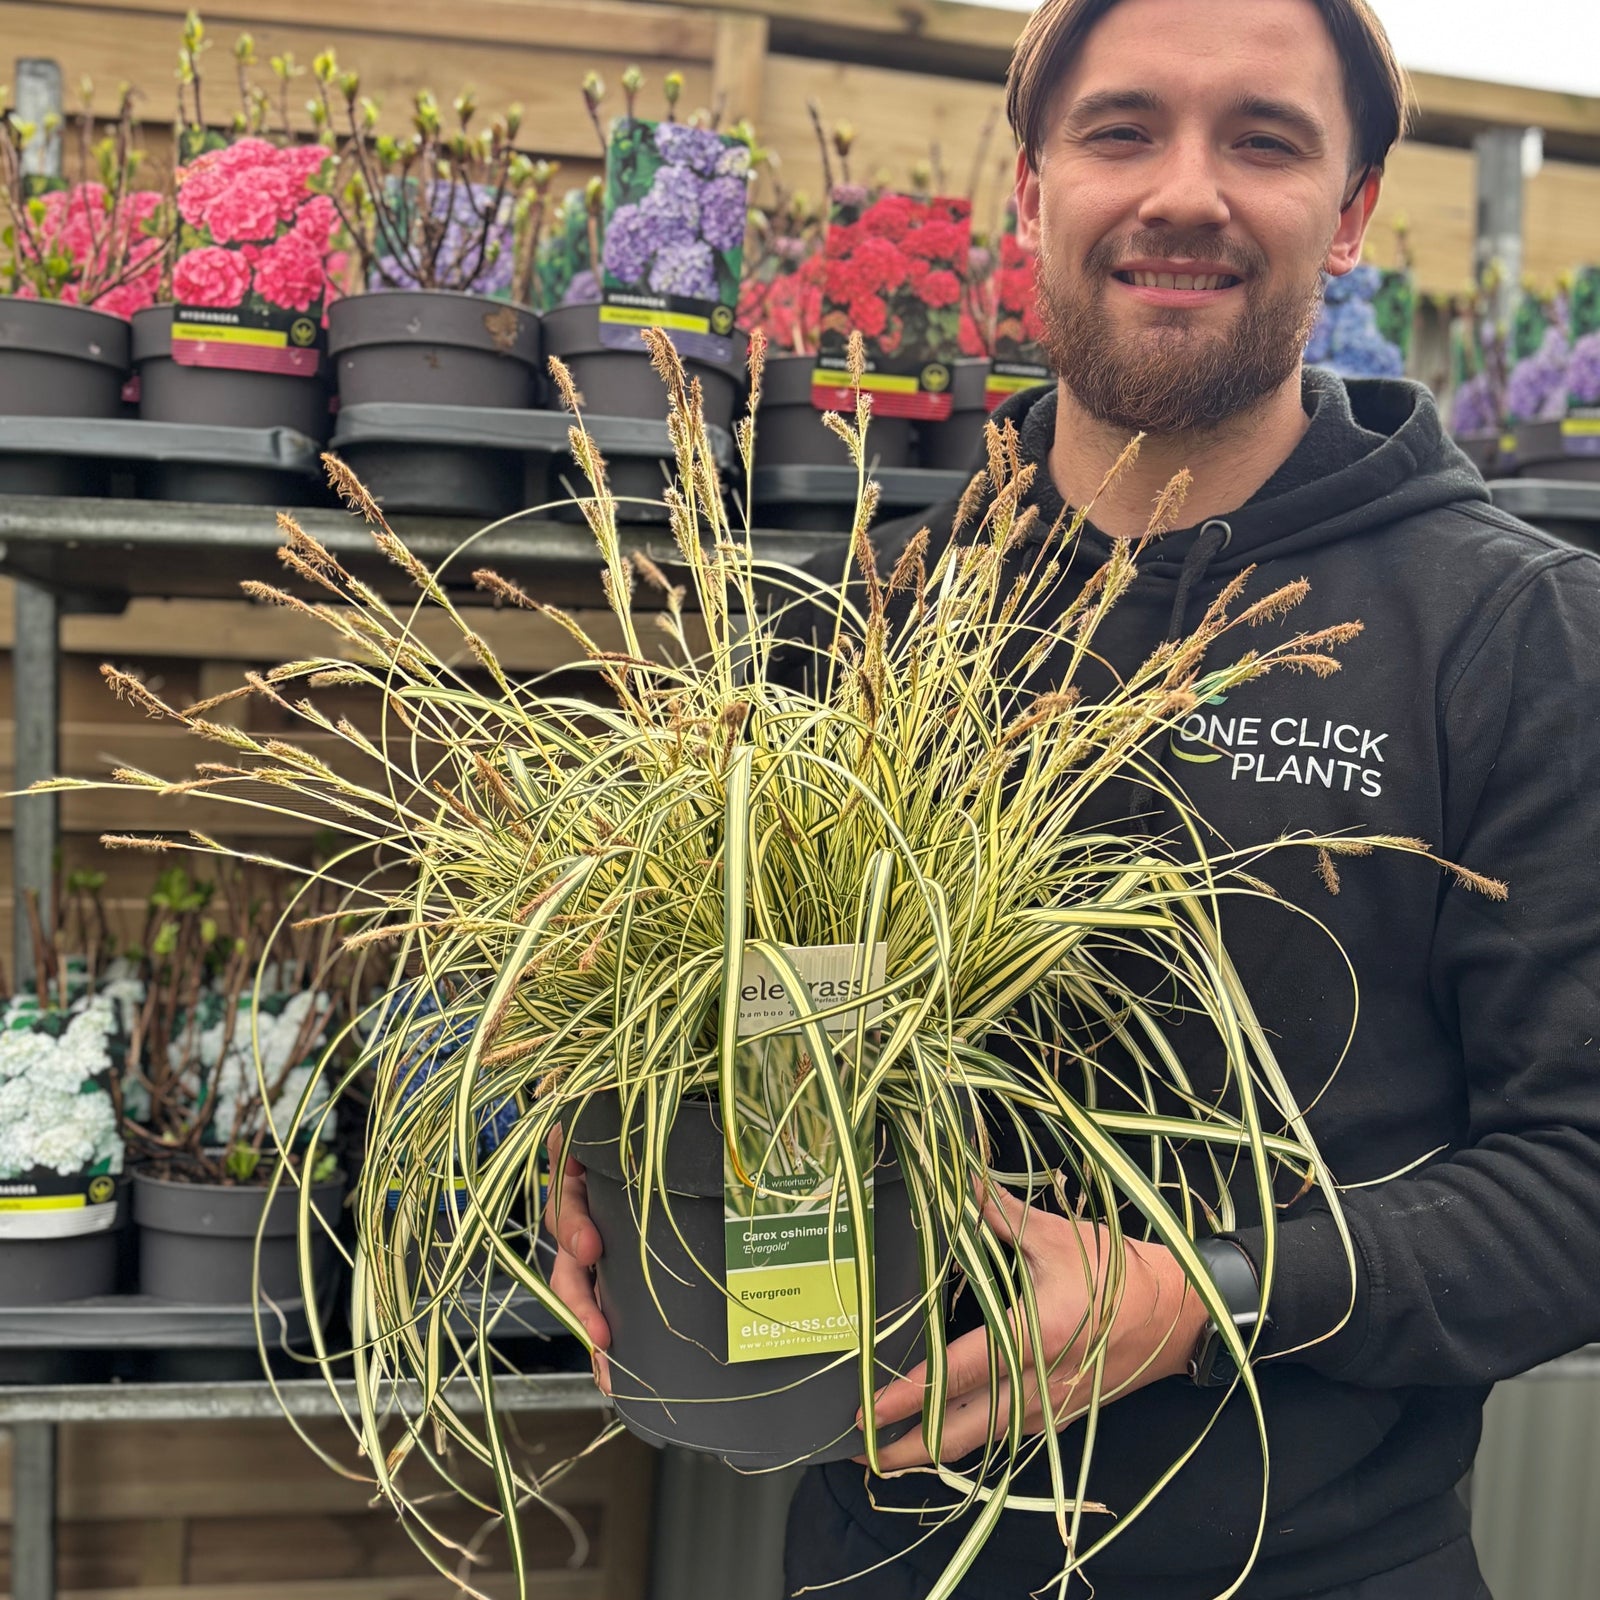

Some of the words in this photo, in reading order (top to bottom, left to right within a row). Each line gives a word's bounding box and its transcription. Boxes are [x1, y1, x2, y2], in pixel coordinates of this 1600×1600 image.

[1180, 713, 1261, 747] ONE
[1269, 717, 1389, 763] CLICK
[1231, 753, 1382, 798] PLANTS
[741, 975, 861, 1004] elerass
[739, 1009, 784, 1018] bamboo
[771, 1177, 817, 1188] winterhardy
[742, 1231, 778, 1242] Carex
[780, 1223, 848, 1239] oshimenis
[742, 1241, 790, 1254] 'Evergold'
[741, 1287, 801, 1300] Evergreen
